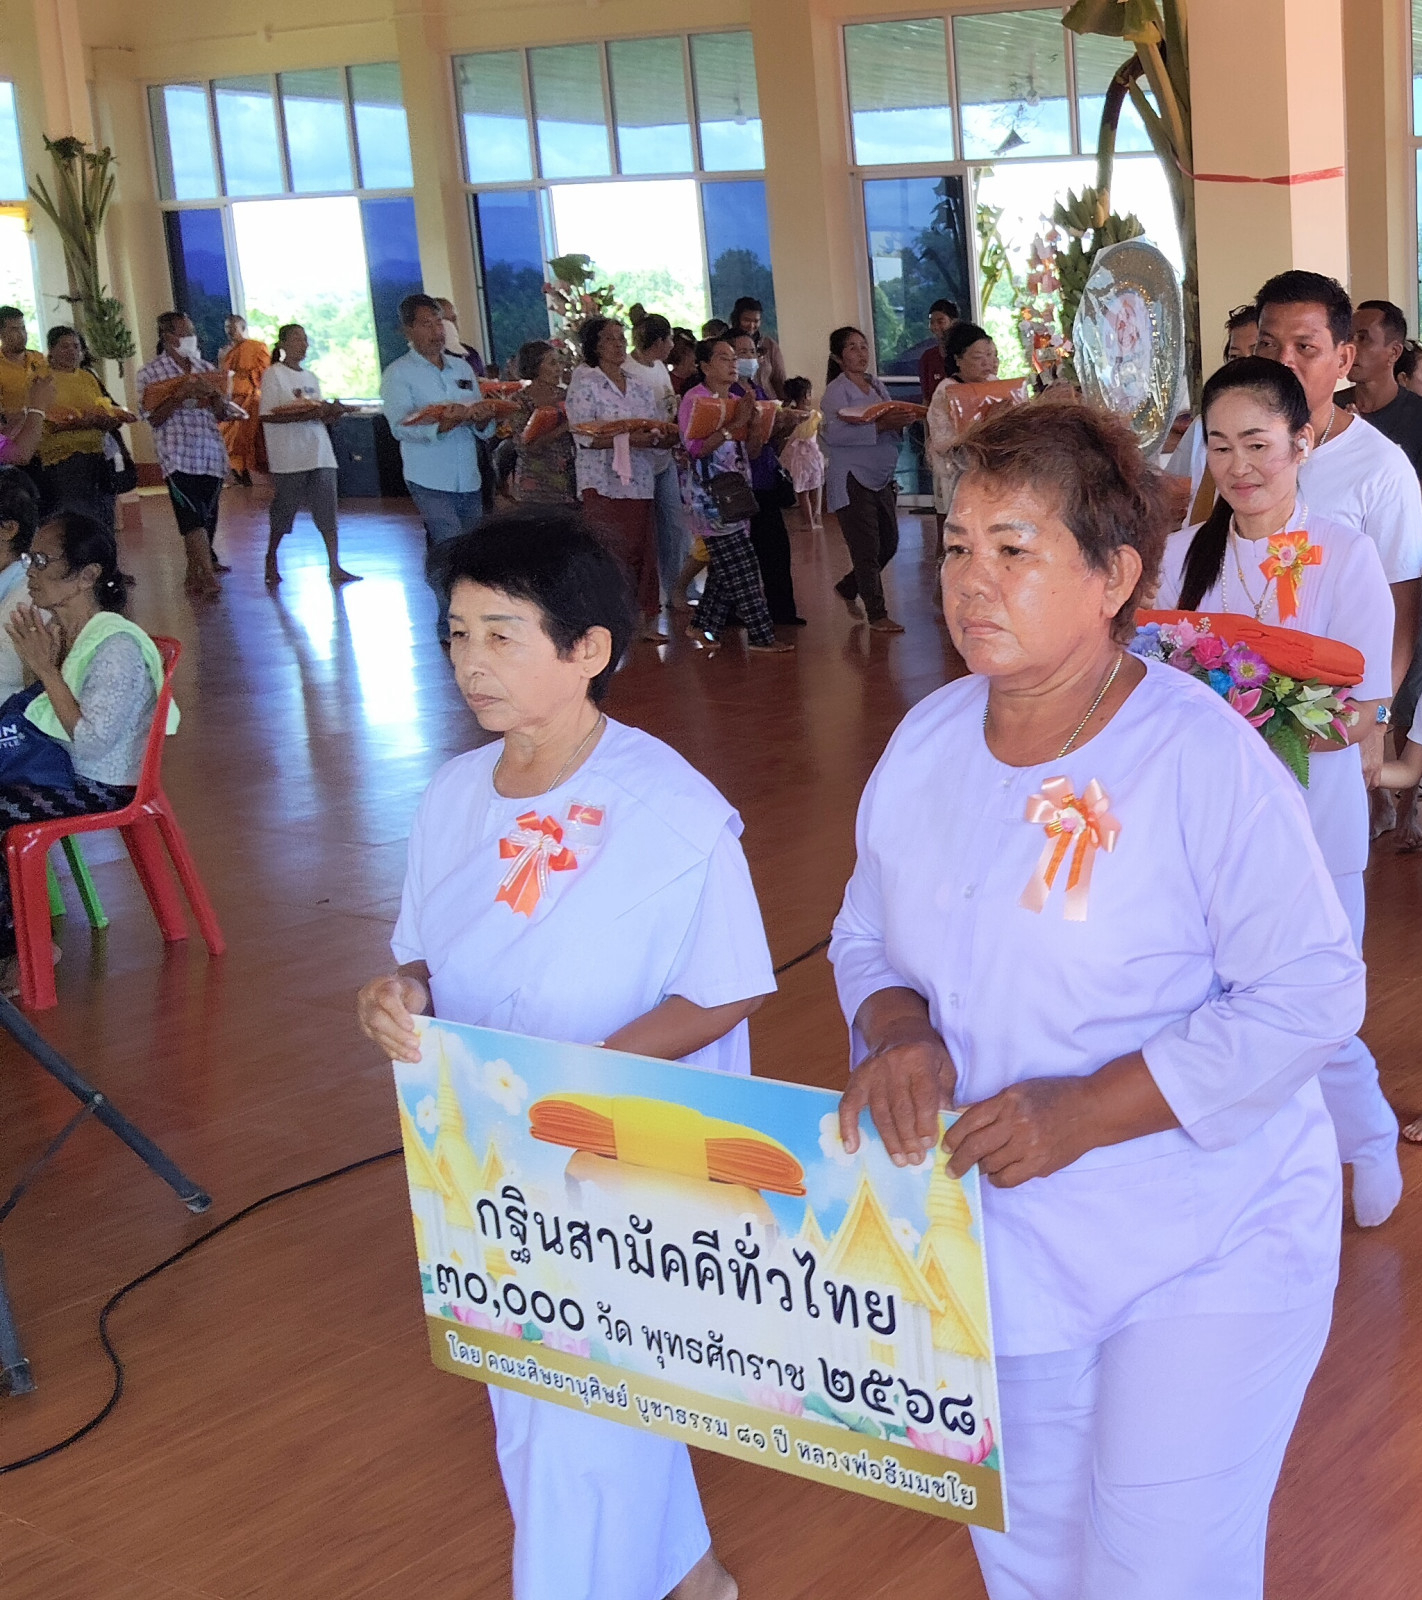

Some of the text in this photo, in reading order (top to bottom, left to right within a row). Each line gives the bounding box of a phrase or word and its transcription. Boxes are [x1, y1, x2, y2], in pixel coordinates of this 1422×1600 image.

[476, 1185, 897, 1336] กฐินสามัคคีทั่วไทย
[436, 1263, 976, 1436] ๓๐,๐๐๐ วัด พุทธศักราช ๒๕๖๘
[448, 1333, 975, 1506] โดย คณะศิษยานุศิษย์ บูชาธรรม ๘๑ ปี หลวงพ่อธัมมชโย
